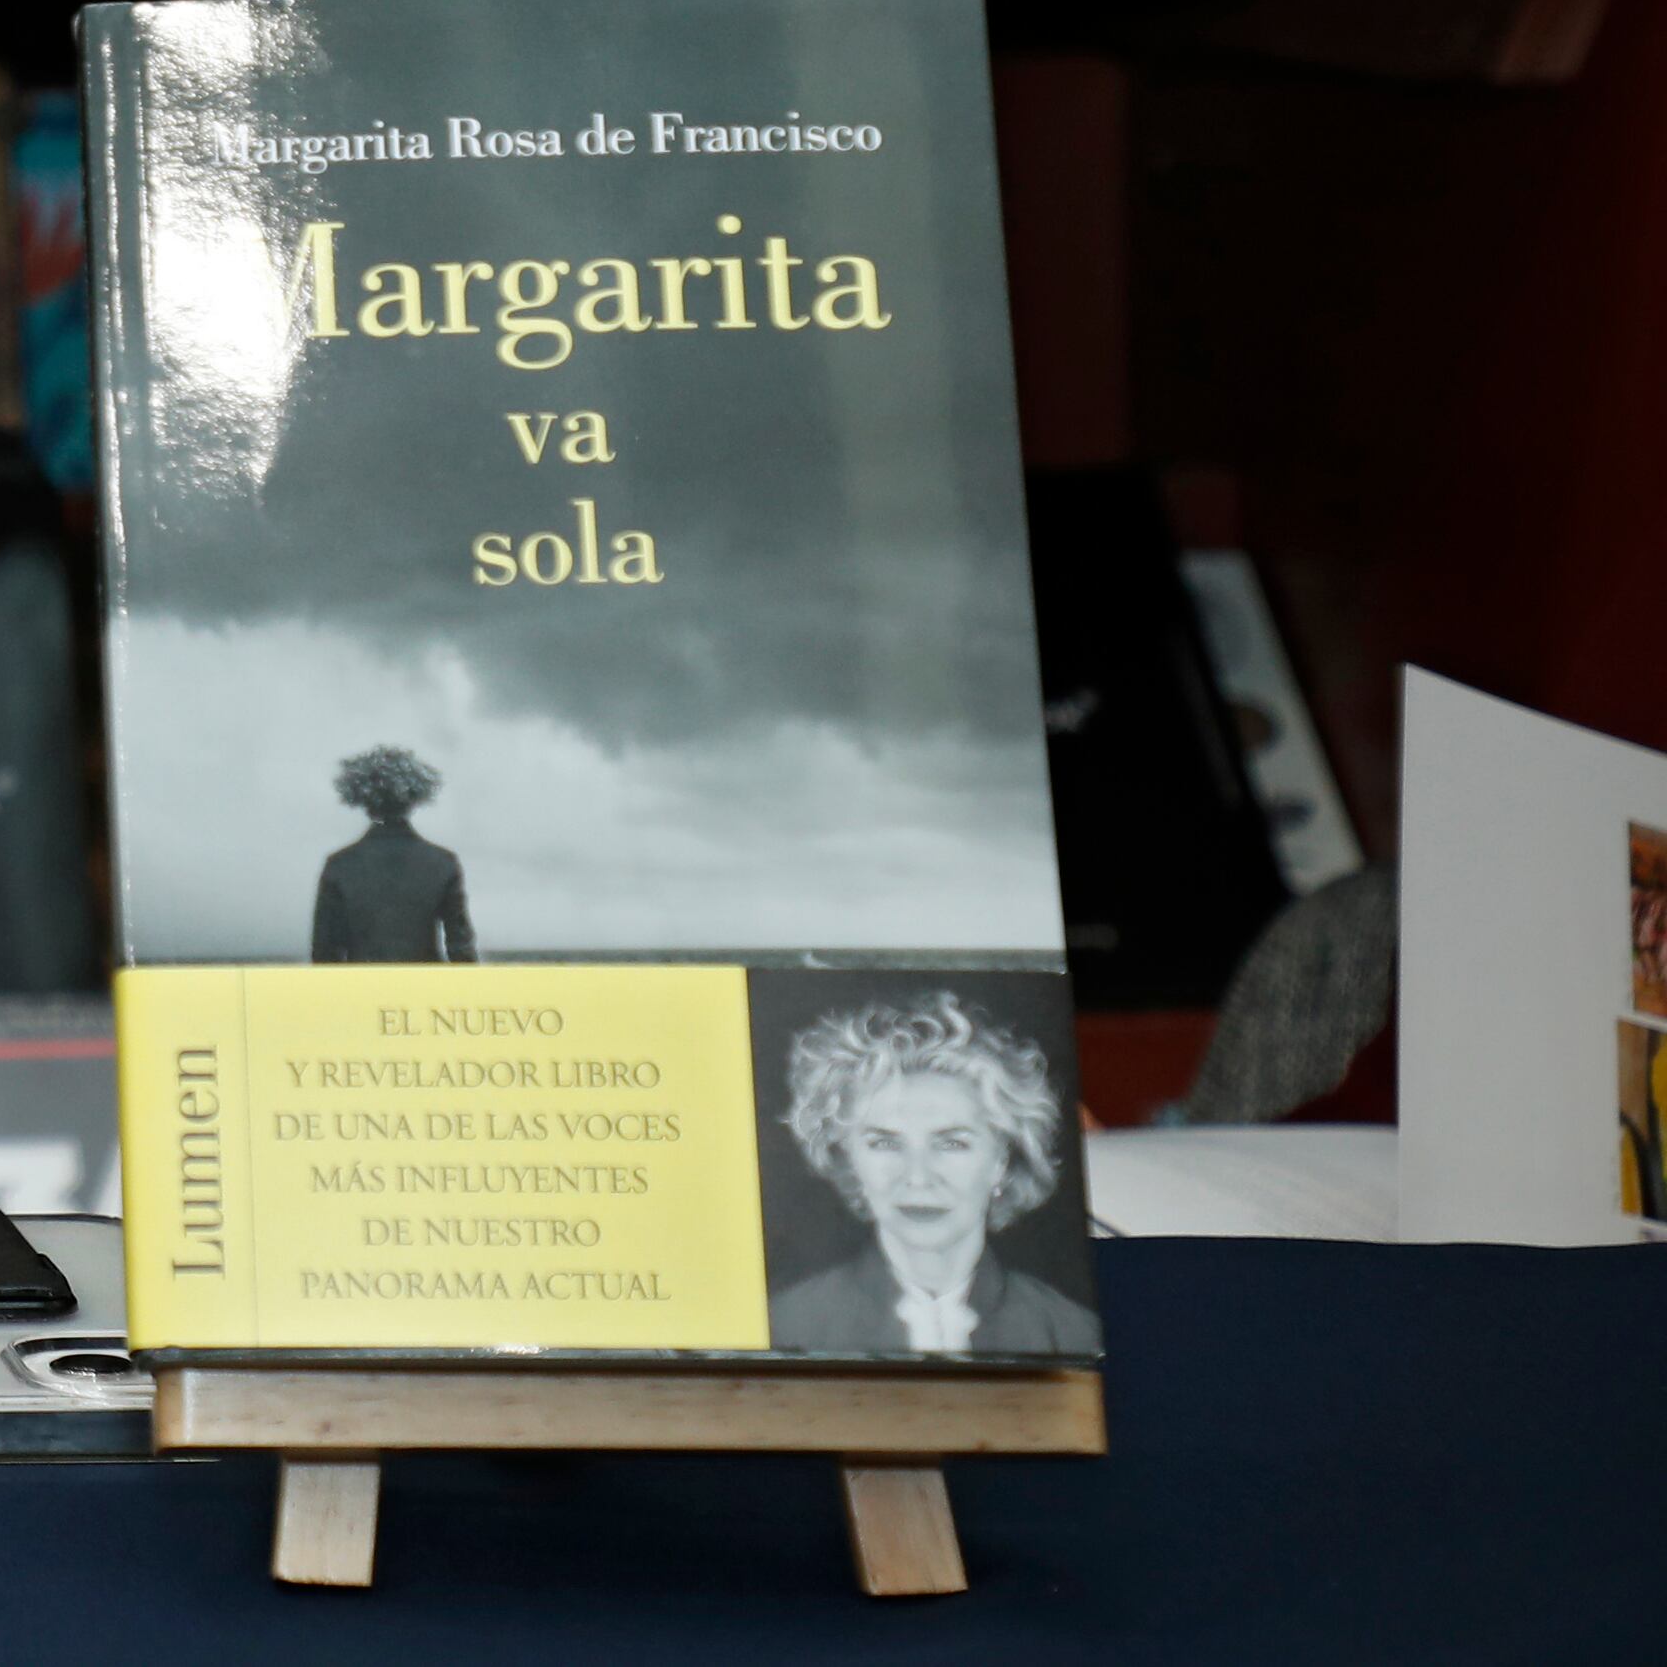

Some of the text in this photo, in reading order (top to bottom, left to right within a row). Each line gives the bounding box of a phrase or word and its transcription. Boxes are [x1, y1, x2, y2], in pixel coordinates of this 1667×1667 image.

[210, 110, 882, 175] Margarita Rosa de Francisco
[507, 410, 616, 465] va
[474, 497, 665, 587] sola
[379, 1007, 564, 1037] EL NUEVO
[285, 1059, 661, 1089] Y REVELADOR LIBRO
[274, 1112, 681, 1143] DE UNA DE LAS VOCES
[170, 1043, 226, 1280] Lumen
[310, 1160, 649, 1195] MÁS INFLUYENTES
[362, 1217, 601, 1248] DE NUESTRO
[300, 1270, 672, 1302] PANORAMA ACTUAL
